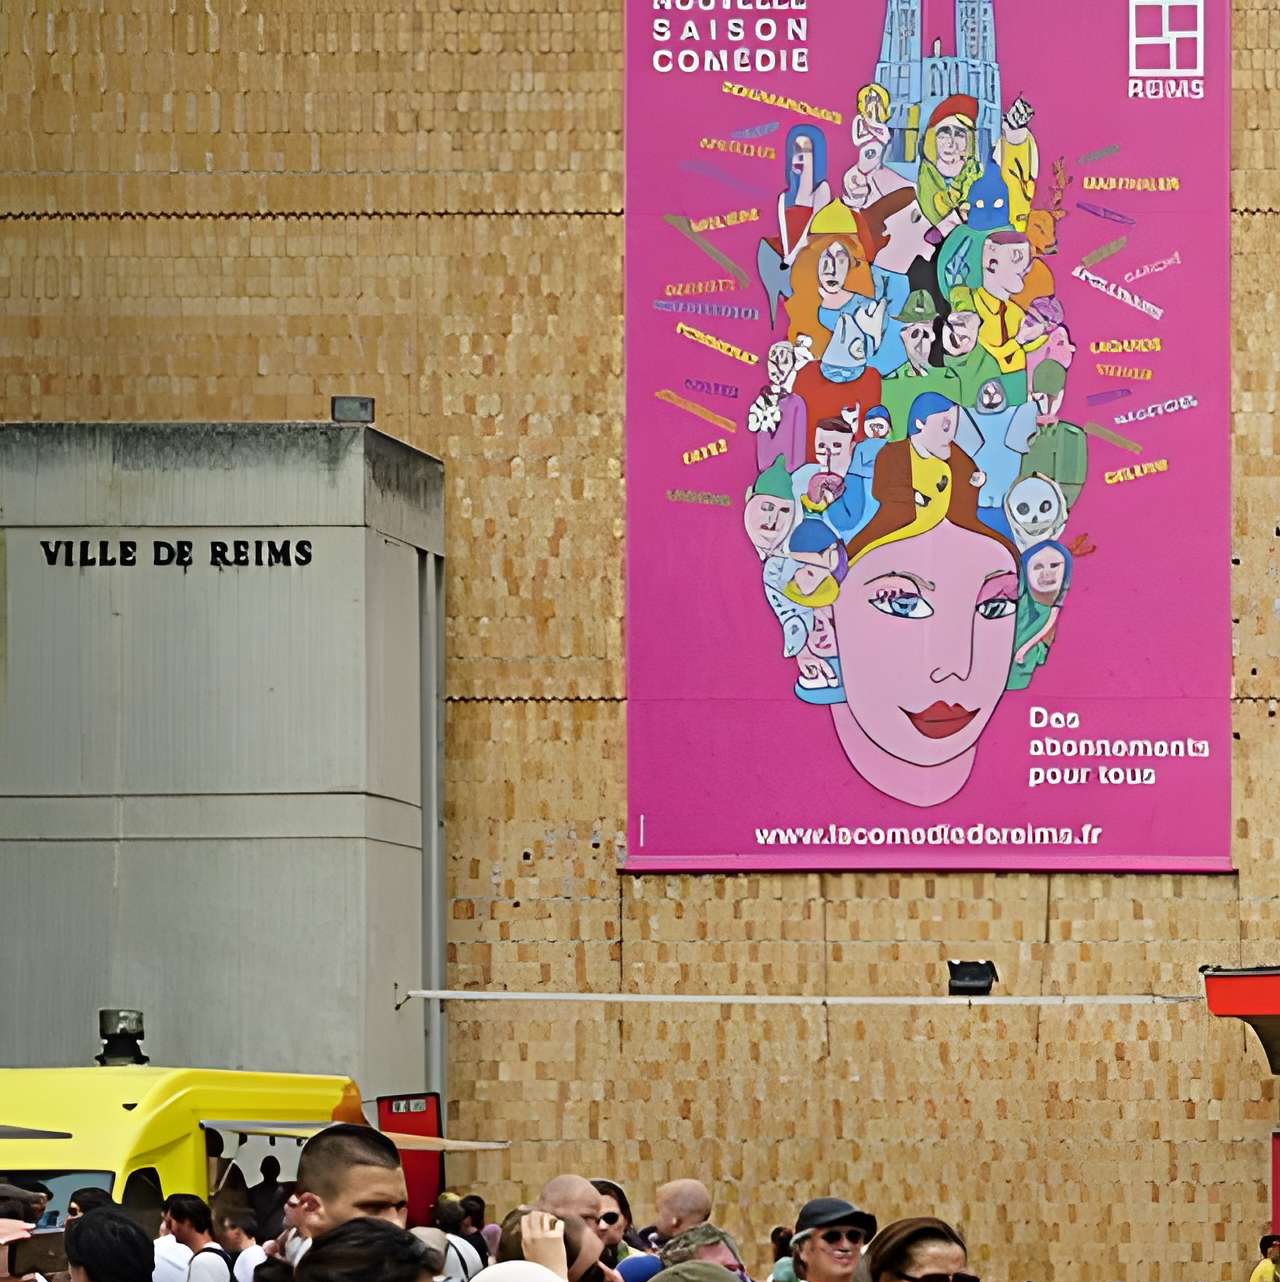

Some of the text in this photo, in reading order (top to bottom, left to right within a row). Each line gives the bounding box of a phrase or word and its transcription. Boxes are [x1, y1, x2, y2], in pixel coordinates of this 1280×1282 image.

[653, 18, 808, 41] SAISON
[40, 540, 312, 567] VILLE DE REIMS
[1028, 767, 1092, 787] pour
